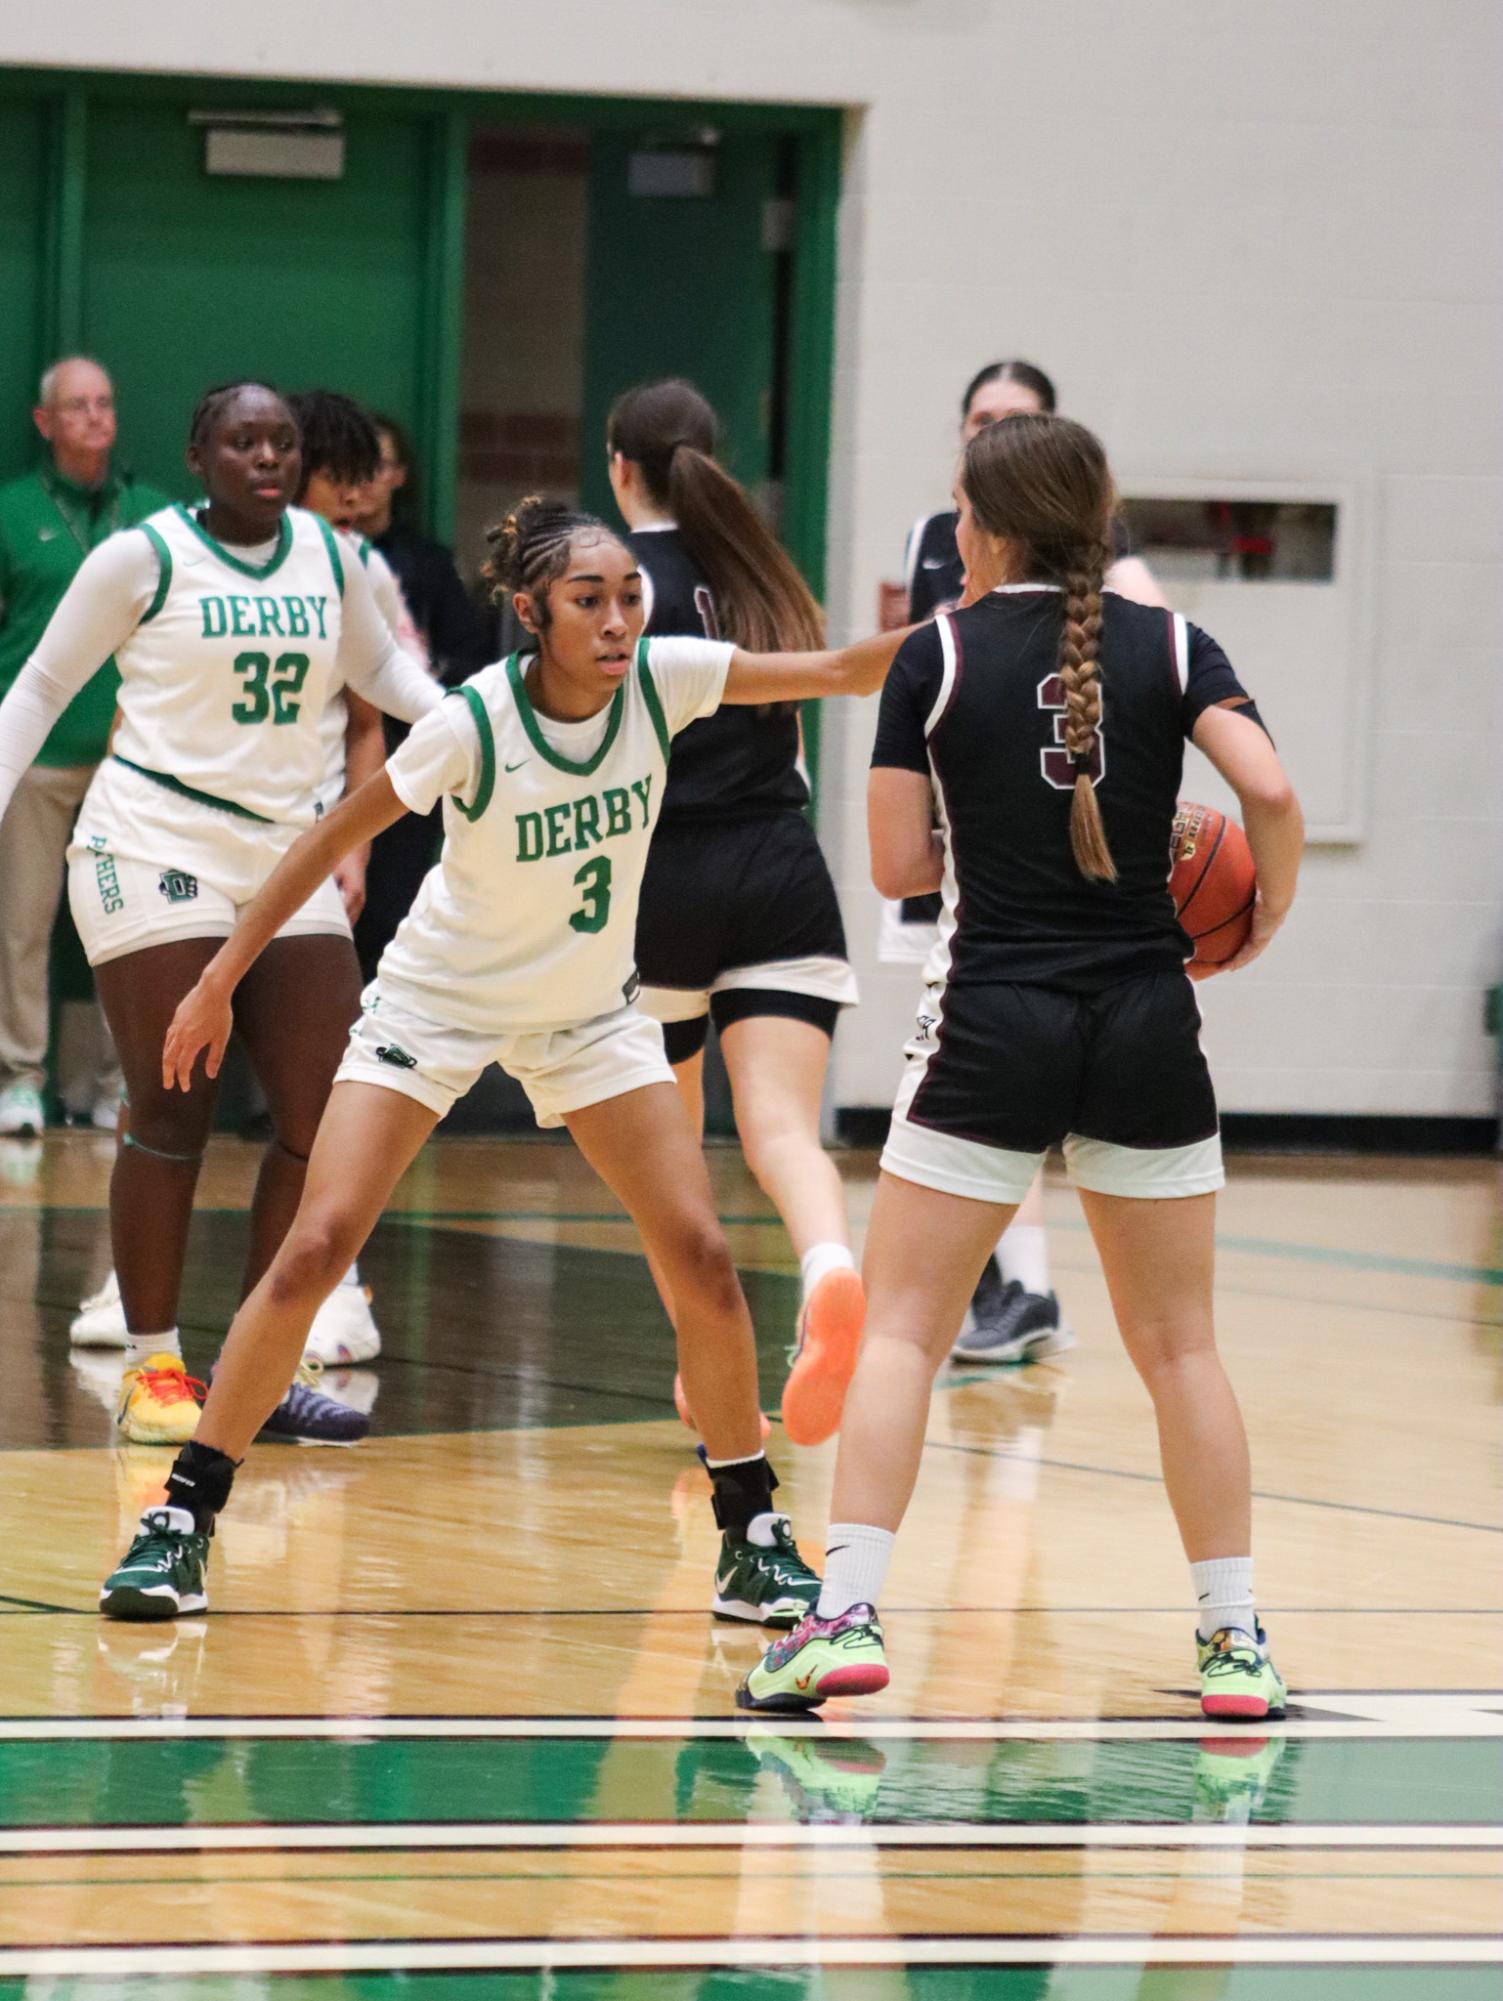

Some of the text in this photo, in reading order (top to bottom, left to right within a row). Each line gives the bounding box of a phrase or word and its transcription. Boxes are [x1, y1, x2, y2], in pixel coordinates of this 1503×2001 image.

[198, 595, 328, 640] DERBY
[232, 651, 311, 726] 32
[1037, 672, 1106, 790] 3
[515, 773, 652, 863] DERBY
[568, 854, 612, 935] 3
